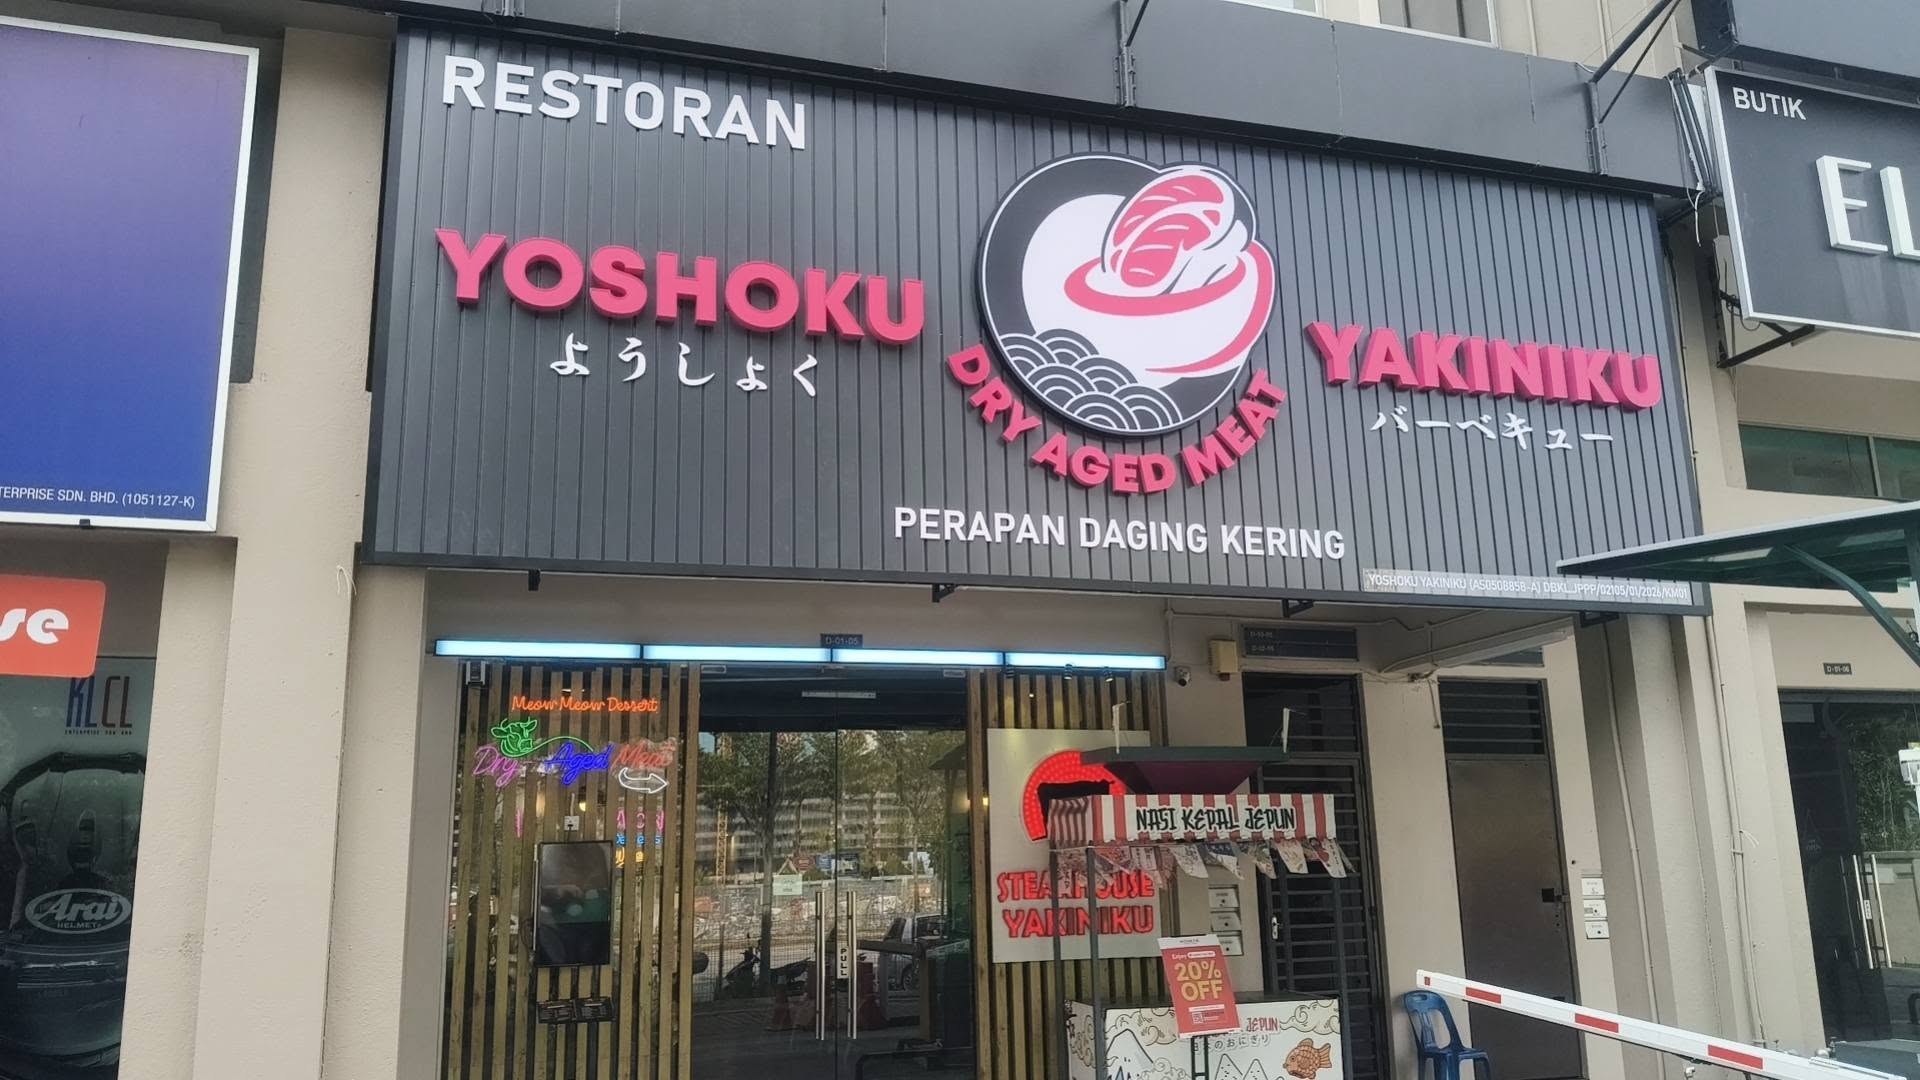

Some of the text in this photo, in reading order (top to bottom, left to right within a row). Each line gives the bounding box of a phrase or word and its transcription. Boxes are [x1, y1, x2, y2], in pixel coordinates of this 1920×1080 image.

[442, 55, 806, 150] RESTORAN
[1732, 86, 1806, 120] BUTIK
[435, 228, 924, 344] YOSHOKU
[550, 333, 817, 396] ようしょく
[1305, 320, 1662, 410] YAKINIKU
[946, 343, 1287, 493] DRY AGED MEAT
[1370, 405, 1614, 450] バーベキュー
[57, 489, 86, 502] SDN.
[90, 491, 119, 504] BHD.
[122, 493, 195, 509] (1051127-K)
[894, 506, 1346, 560] PERAPAN DAGING KERING
[1368, 574, 1418, 587] YOSHOKU
[1420, 576, 1467, 589] YAKINIKU
[511, 696, 658, 713] Meow Meow Dessert
[472, 741, 675, 787] Dry Aged Meat
[1136, 806, 1295, 831] NASI KEPAL JEPUN
[34, 893, 119, 921] Arai
[1002, 905, 1153, 938] YAKINIKU
[840, 948, 848, 976] PULL
[1174, 960, 1222, 981] 20%
[1181, 980, 1223, 1001] OFF
[1246, 1017, 1278, 1032] JEPUN
